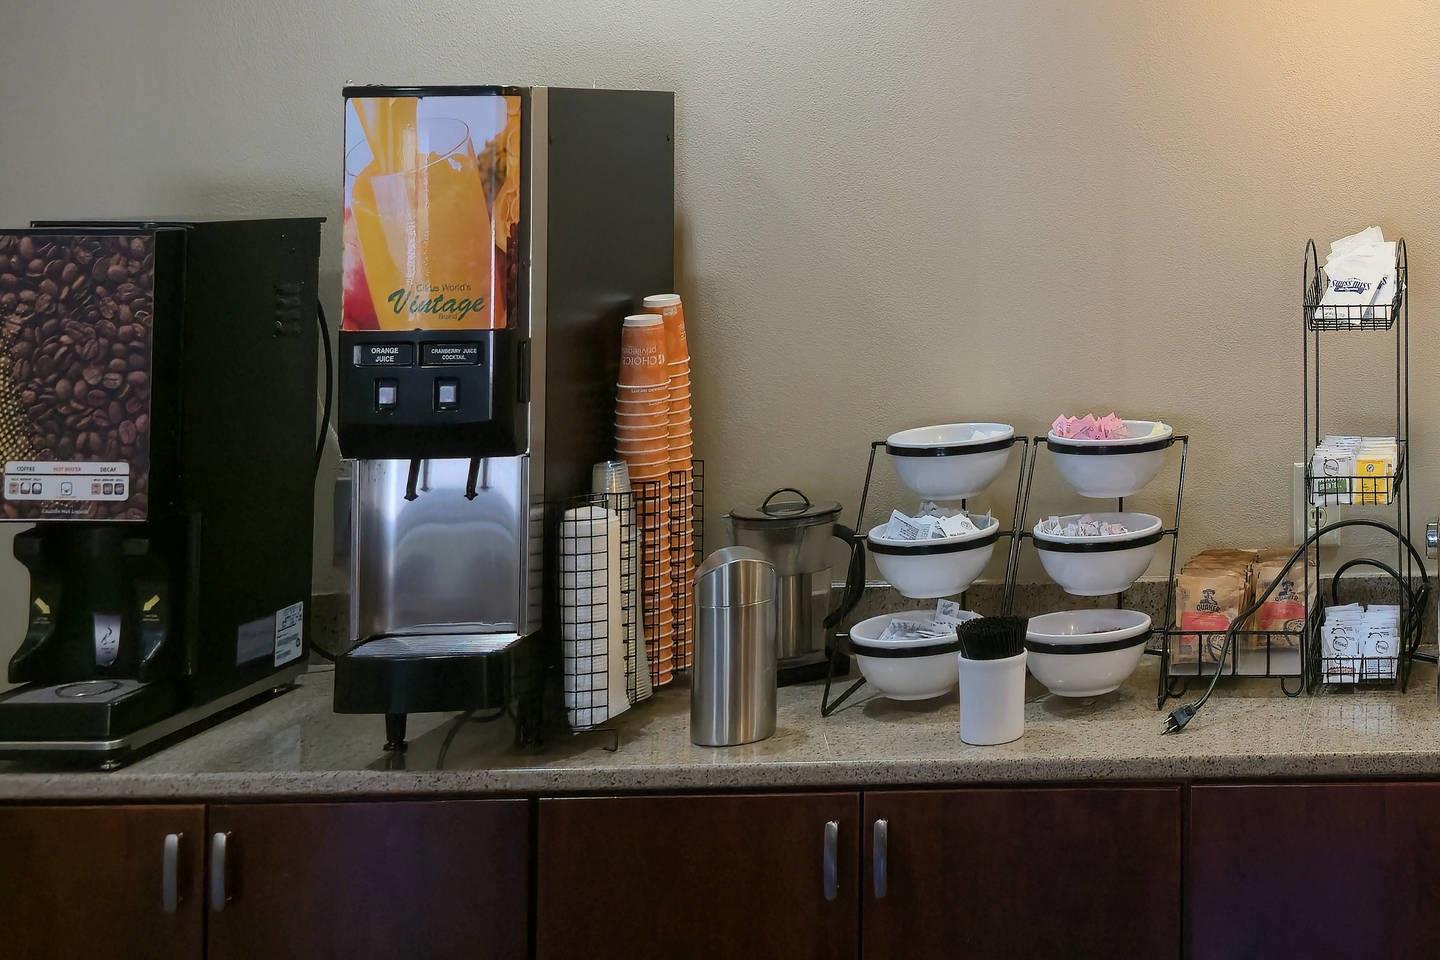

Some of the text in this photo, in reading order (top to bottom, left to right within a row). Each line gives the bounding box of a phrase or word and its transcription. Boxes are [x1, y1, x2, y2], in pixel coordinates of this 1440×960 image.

[442, 283, 472, 292] World's
[387, 288, 486, 320] Vintage
[375, 355, 395, 363] JUICE
